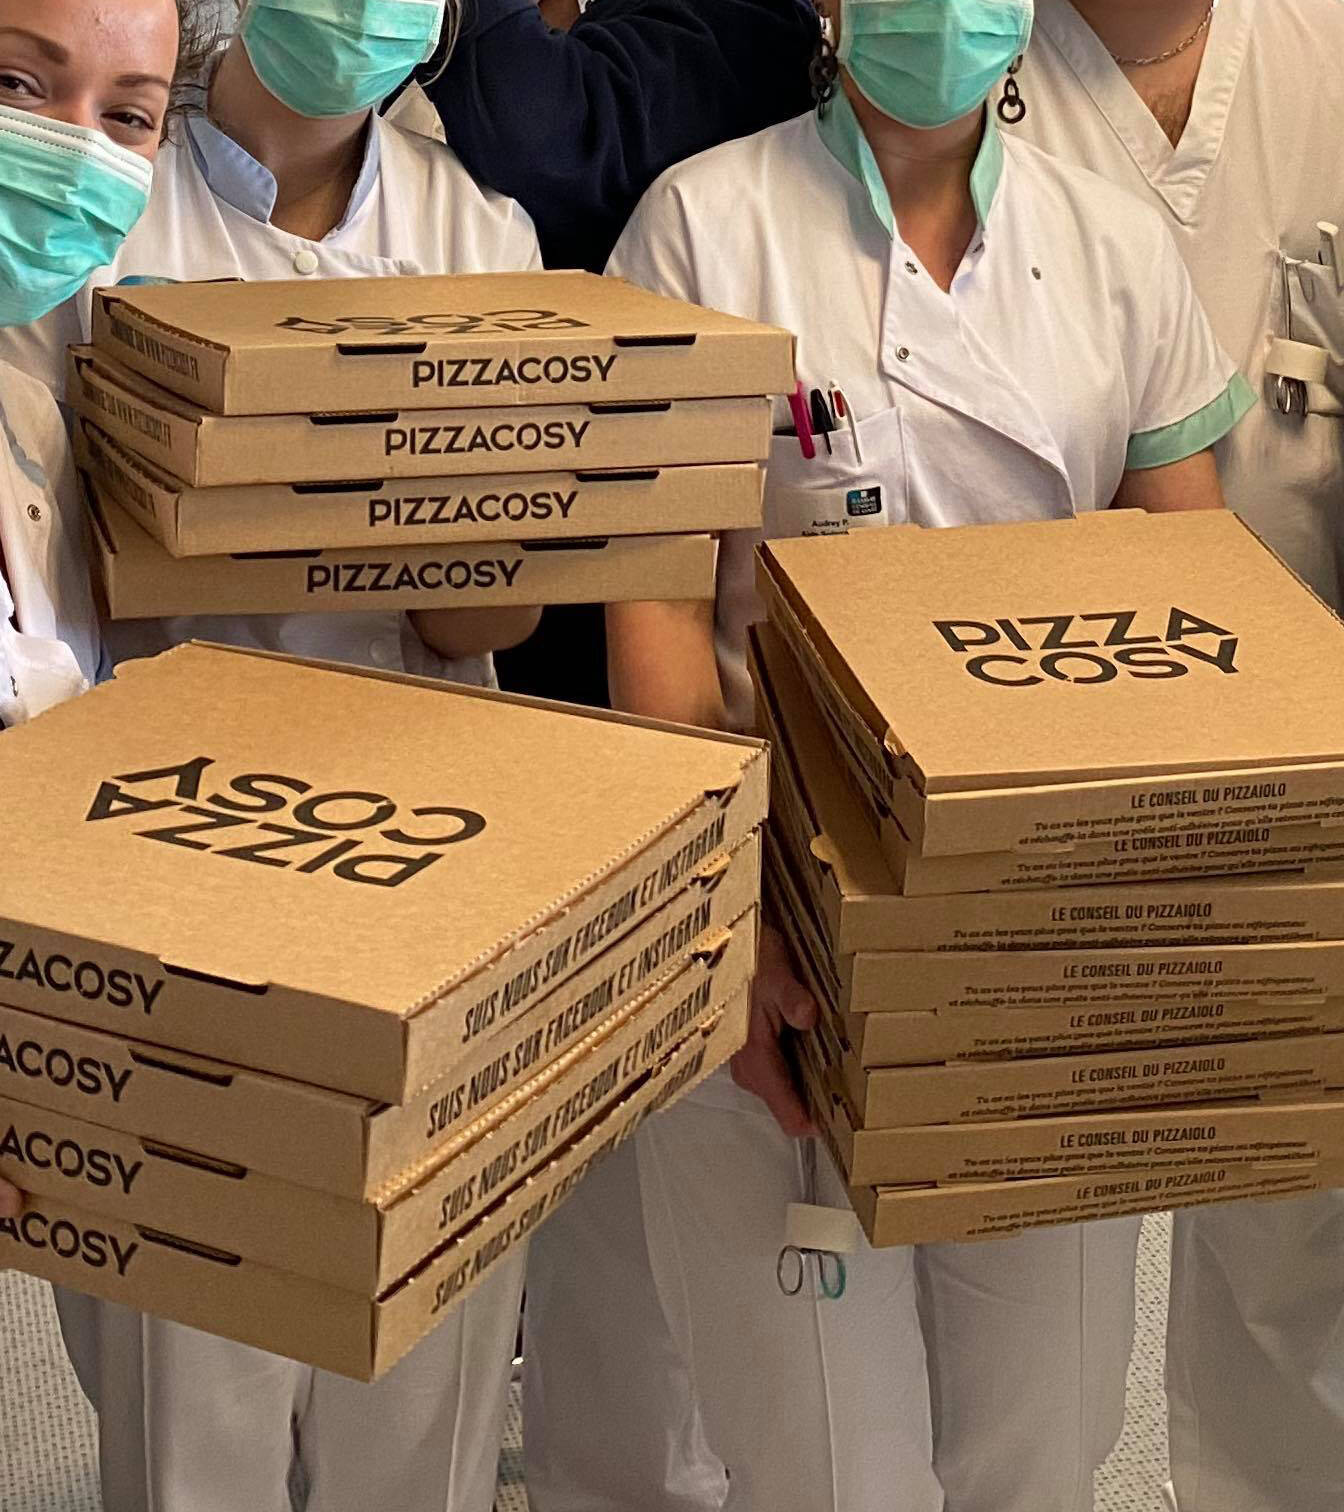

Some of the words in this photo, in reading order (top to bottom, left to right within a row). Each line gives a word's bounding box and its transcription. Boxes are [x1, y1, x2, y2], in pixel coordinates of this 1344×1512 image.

[412, 354, 618, 388] PIZZACOSY
[385, 421, 591, 456] PIZZACOSY
[368, 491, 578, 526] PIZZACOSY
[307, 559, 524, 593] PIZZACOSY
[932, 606, 1235, 653] PIZZA
[965, 638, 1241, 688] COSY
[112, 756, 487, 846] COSY
[1131, 794, 1145, 809] LE
[1149, 791, 1198, 807] CONSEIL
[1203, 787, 1219, 803] DU
[1223, 783, 1286, 801] PIZZAIOLO
[85, 780, 445, 887] PIZZA
[1114, 838, 1128, 852] LE
[1132, 834, 1181, 851] CONSEIL
[1186, 832, 1202, 846] DU
[1207, 828, 1270, 846] PIZZAIOLO
[462, 990, 499, 1044] SUIS
[500, 958, 542, 1017] NOUS
[542, 936, 573, 984] SUR
[573, 887, 638, 962] FACEBOOK
[640, 870, 658, 908] ET
[658, 812, 725, 894] INSTAGRAM
[1052, 907, 1065, 921] LE
[1070, 905, 1120, 921] CONSEIL
[1126, 905, 1142, 919] DU
[1147, 903, 1212, 918] PIZZAIOLO
[1064, 965, 1078, 978] LE
[1081, 963, 1131, 978] CONSEIL
[1137, 963, 1153, 976] DU
[1158, 961, 1223, 975] PIZZAIOLO
[426, 1084, 464, 1138] SUIS
[469, 1051, 510, 1109] NOUS
[513, 1028, 543, 1077] SUR
[545, 973, 616, 1052] FACEBOOK
[618, 958, 637, 997] ET
[637, 897, 711, 982] INSTAGRAM
[1070, 1014, 1084, 1028] LE
[1088, 1011, 1136, 1026] CONSEIL
[1141, 1009, 1157, 1022] DU
[1161, 1004, 1224, 1021] PIZZAIOLO
[1072, 1070, 1085, 1083] LE
[1089, 1065, 1138, 1081] CONSEIL
[1143, 1063, 1159, 1077] DU
[1163, 1058, 1226, 1075] PIZZAIOLO
[439, 1175, 476, 1229] SUIS
[478, 1141, 520, 1199] NOUS
[521, 1115, 551, 1164] SUR
[552, 1056, 621, 1138] FACEBOOK
[622, 1038, 642, 1078] ET
[641, 976, 712, 1063] INSTAGRAM
[1060, 1134, 1074, 1148] LE
[1078, 1131, 1128, 1147] CONSEIL
[1132, 1130, 1149, 1143] DU
[1153, 1126, 1216, 1143] PIZZAIOLO
